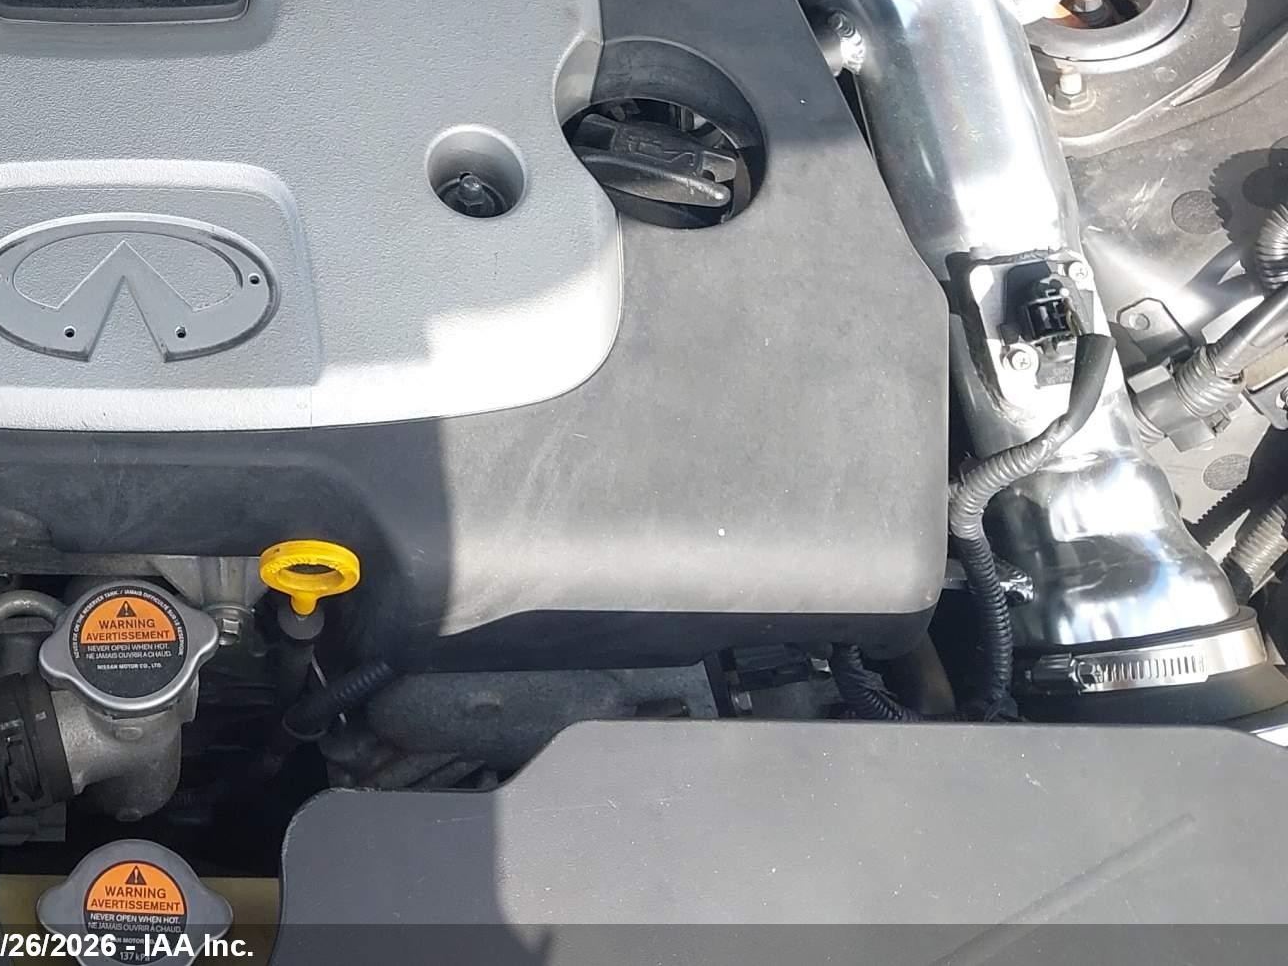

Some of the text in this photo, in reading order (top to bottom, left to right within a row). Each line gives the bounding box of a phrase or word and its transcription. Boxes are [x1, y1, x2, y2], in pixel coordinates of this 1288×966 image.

[98, 618, 155, 630] WARNING
[86, 630, 170, 642] AVERTISSEMENT
[87, 644, 110, 652] NEVER
[131, 643, 153, 651] WHEN
[105, 885, 167, 899] WARNING
[90, 898, 181, 912] AVERTISSEMENT
[90, 913, 181, 924] NEVER OPEN WHEN HOT.
[98, 922, 123, 930] JAMAIS
[123, 924, 149, 932] OUVRIR
[119, 951, 135, 961] 137
